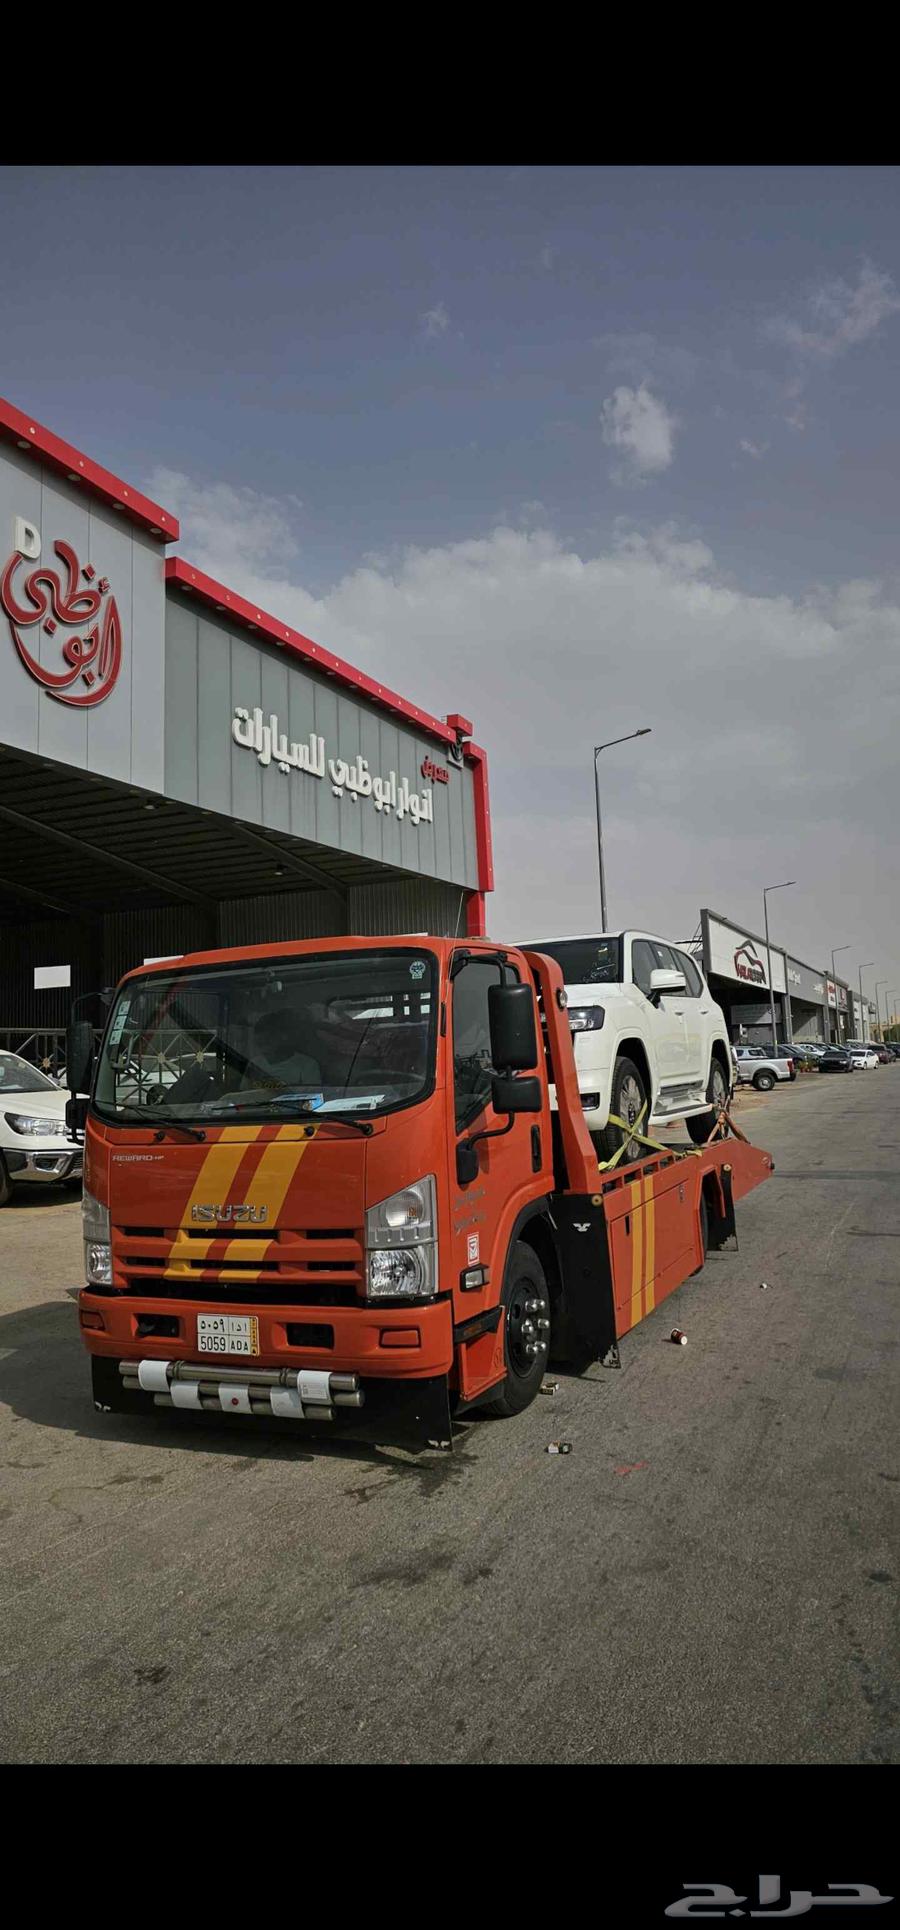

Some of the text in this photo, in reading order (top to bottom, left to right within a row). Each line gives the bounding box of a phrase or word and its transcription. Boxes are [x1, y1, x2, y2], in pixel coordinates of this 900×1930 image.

[232, 707, 325, 777] للسيارات
[192, 1204, 267, 1223] ISUZU
[200, 1335, 249, 1352] 5059 ADA
